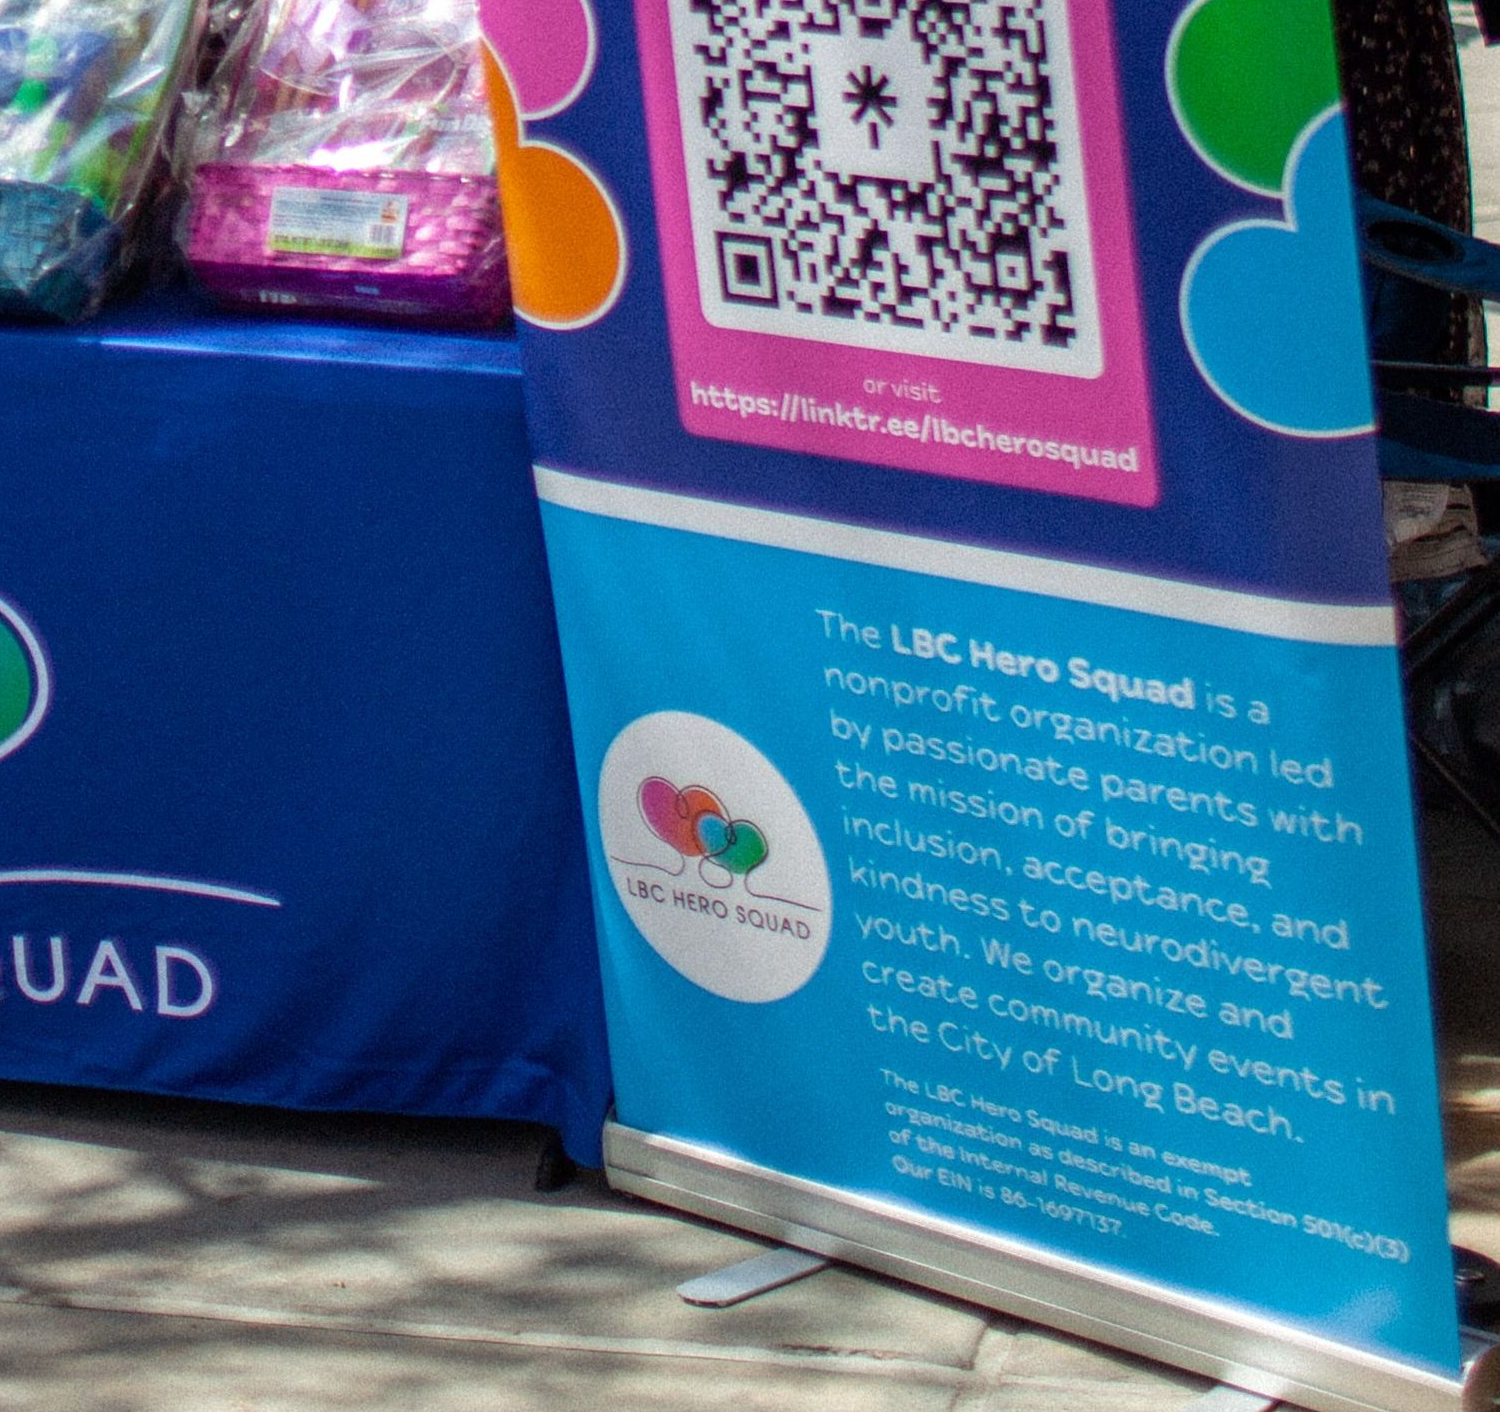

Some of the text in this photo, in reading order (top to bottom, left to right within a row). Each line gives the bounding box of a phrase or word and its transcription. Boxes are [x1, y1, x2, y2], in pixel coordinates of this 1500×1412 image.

[690, 381, 1139, 473] https://linktr.ee/lbcherosquad
[862, 376, 942, 405] or visit
[815, 607, 1270, 724] The LBC Hero Squad is a
[824, 667, 1334, 789] nonprofit organization led
[830, 713, 1363, 844] by passionate parents with
[835, 761, 1271, 888] the mission of bringing
[841, 804, 1351, 950] inclusion, acceptance, and
[626, 877, 810, 940] LBC HERO SQUAD
[850, 866, 1388, 1010] kindness to neurodivergent
[858, 917, 1294, 1040] youth. We organize and
[862, 960, 1396, 1114] create community events in
[867, 1005, 1304, 1143] the City of Long Beach.
[879, 1067, 1252, 1187] The LBC Hero Squad is an exempt
[887, 1103, 1022, 1147] organization
[1029, 1143, 1053, 1160] as
[1059, 1150, 1172, 1194] described
[1177, 1178, 1200, 1200] in
[1203, 1187, 1298, 1228] Section
[889, 1128, 1219, 1236] of the Internal Revenue Code.
[891, 1153, 933, 1180] Our
[937, 1167, 973, 1193] EIN
[978, 1178, 997, 1201] is
